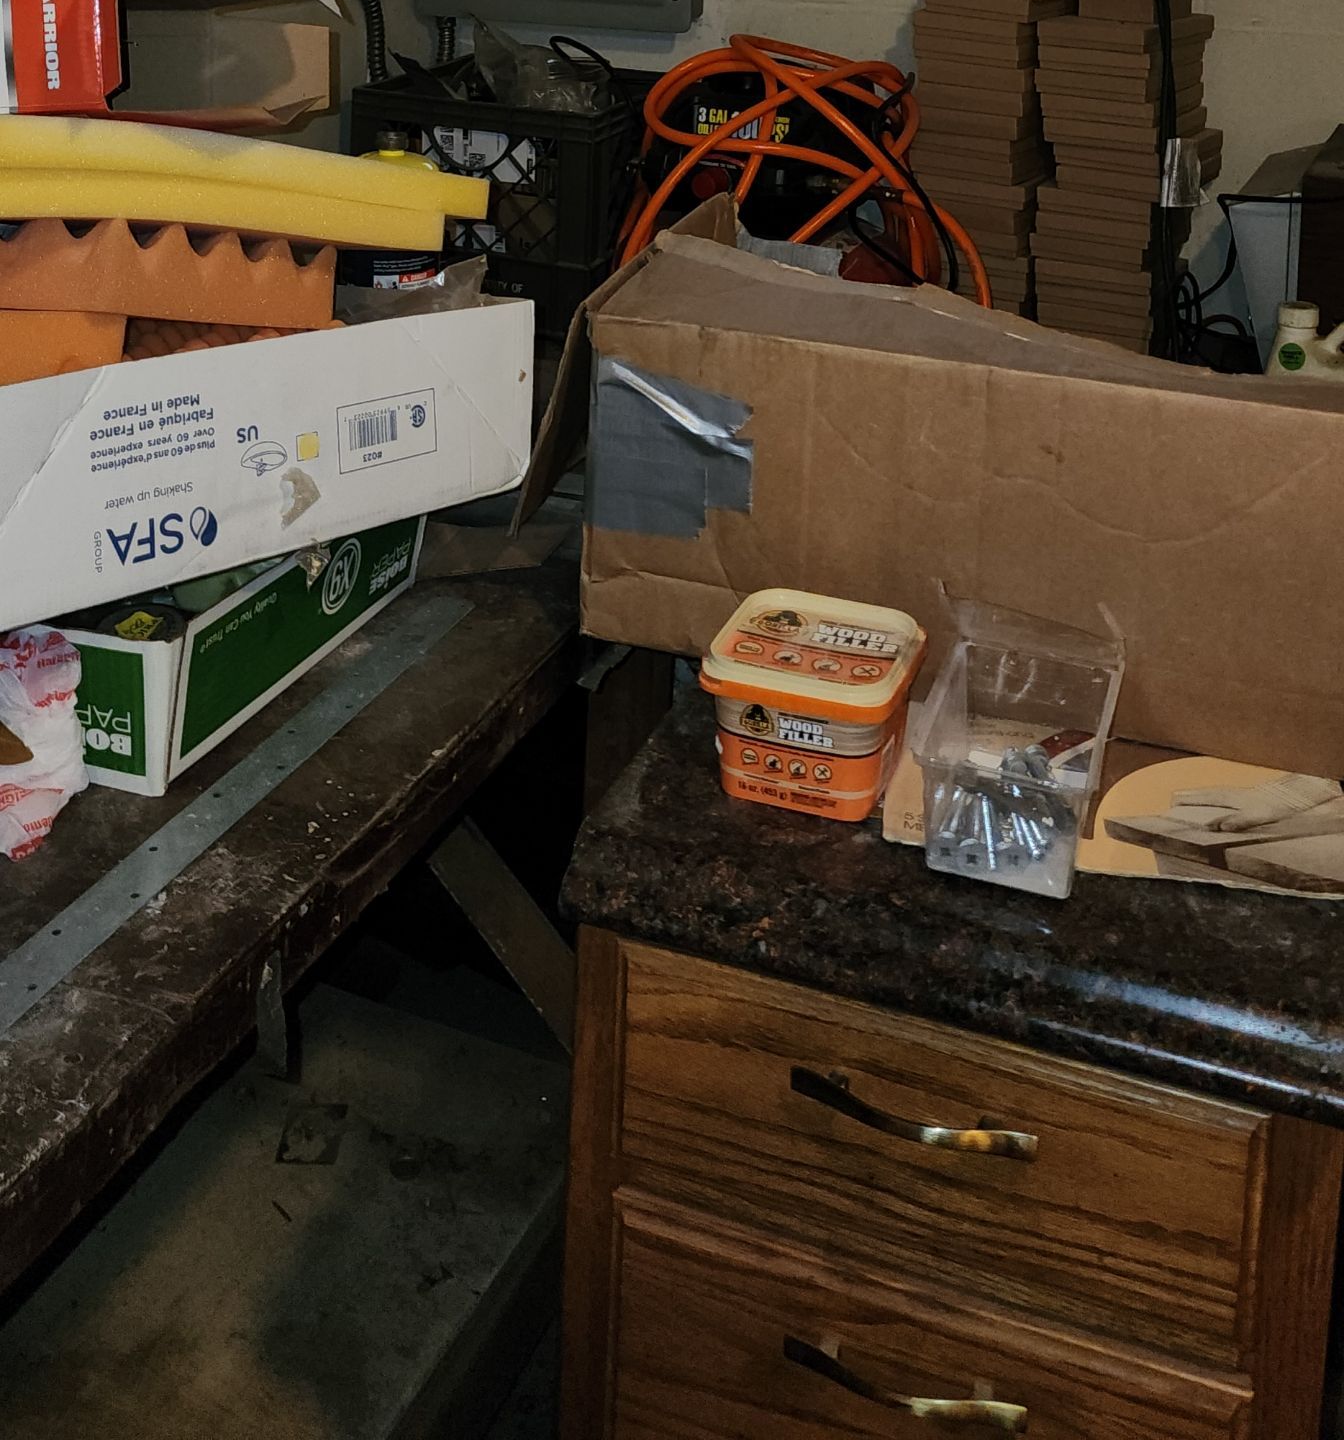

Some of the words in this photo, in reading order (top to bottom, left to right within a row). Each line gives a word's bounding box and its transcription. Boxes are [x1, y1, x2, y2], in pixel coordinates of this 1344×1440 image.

[699, 107, 707, 122] 3
[151, 401, 163, 413] in
[167, 394, 200, 410] Made
[103, 404, 147, 420] France
[159, 408, 214, 430] Fabriqué
[90, 423, 134, 441] France
[139, 419, 154, 431] en
[193, 427, 215, 438] Over
[147, 434, 172, 447] years
[176, 432, 189, 443] 60
[236, 425, 259, 444] US
[90, 441, 143, 459] experience
[170, 445, 183, 457] 60
[184, 442, 196, 454] de
[197, 439, 215, 451] Plus
[91, 451, 152, 472] d'expérience
[153, 448, 169, 459] ans
[363, 451, 383, 463] #023
[137, 490, 151, 501] up
[154, 481, 193, 498] Shaking
[104, 496, 134, 510] water
[106, 513, 184, 566] SFA
[93, 531, 103, 574] GROUP
[818, 624, 886, 643] WOOD
[811, 632, 899, 654] FILLER
[778, 717, 823, 735] WOOD
[778, 729, 835, 748] FILLER
